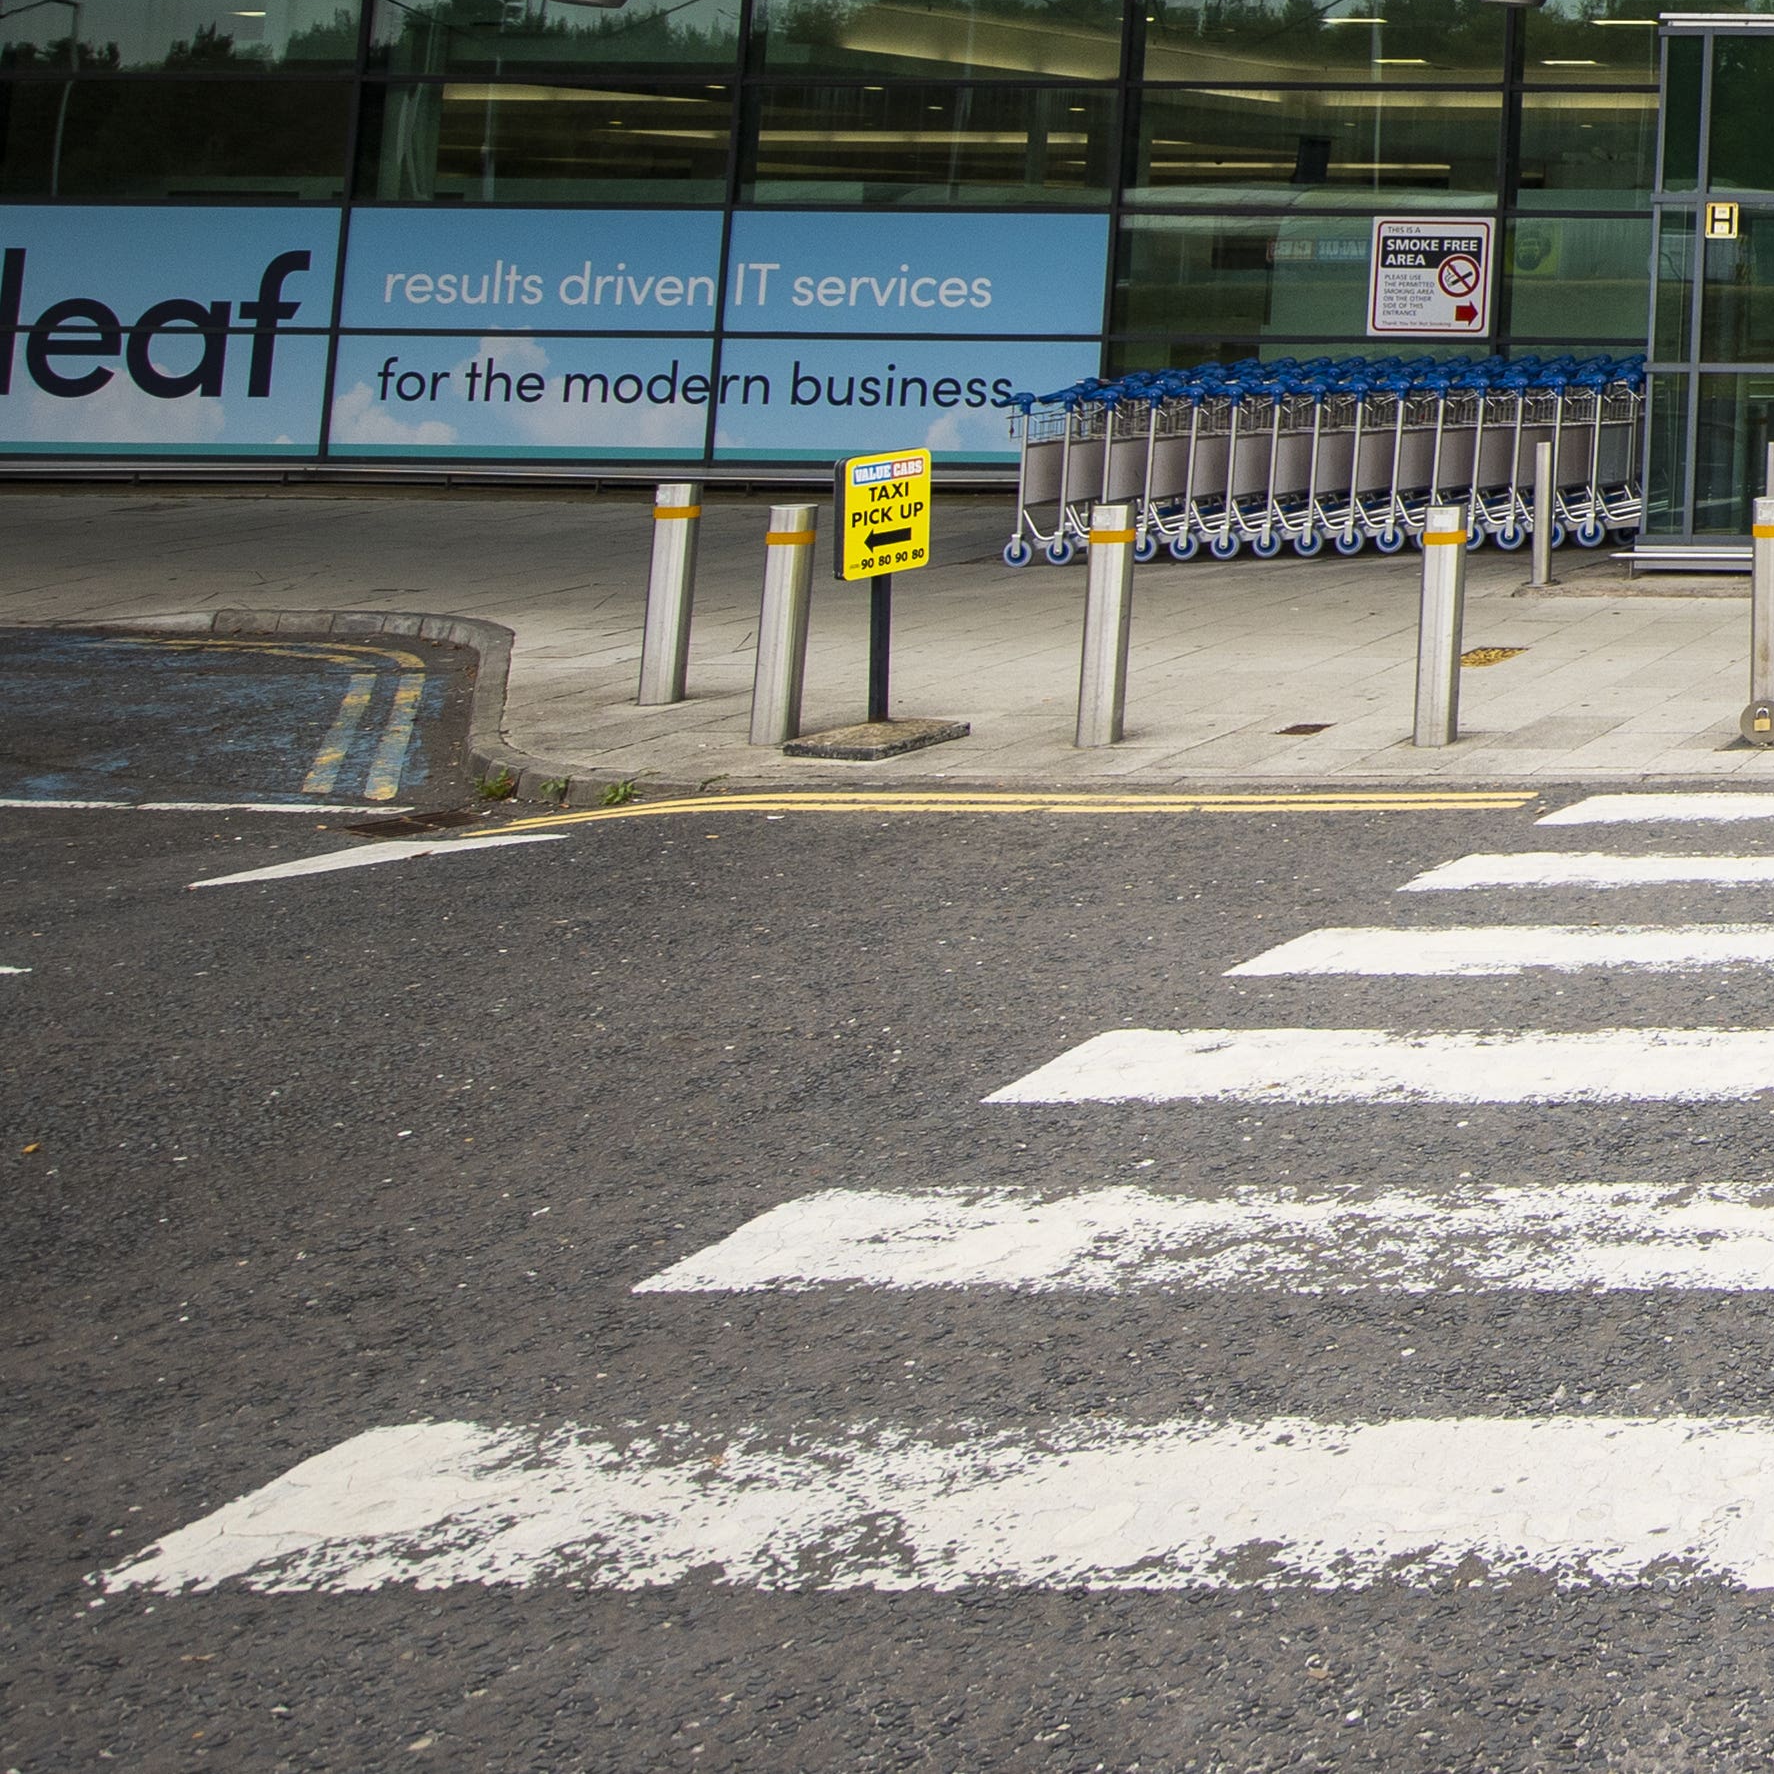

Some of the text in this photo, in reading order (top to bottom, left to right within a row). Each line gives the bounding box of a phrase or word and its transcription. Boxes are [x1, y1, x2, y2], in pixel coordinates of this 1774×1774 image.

[1386, 239, 1478, 251] SMOKE FREE
[1385, 254, 1426, 265] AREA
[383, 260, 993, 309] results driven IT services
[0, 248, 311, 399] leaf
[377, 356, 1014, 409] for the modern business
[854, 460, 923, 483] VALUE CABS
[869, 481, 909, 502] TAXI
[852, 501, 924, 528] PICK UP
[861, 558, 874, 570] 90
[878, 554, 891, 566] 80
[895, 551, 908, 563] 90
[912, 548, 925, 560] 80
